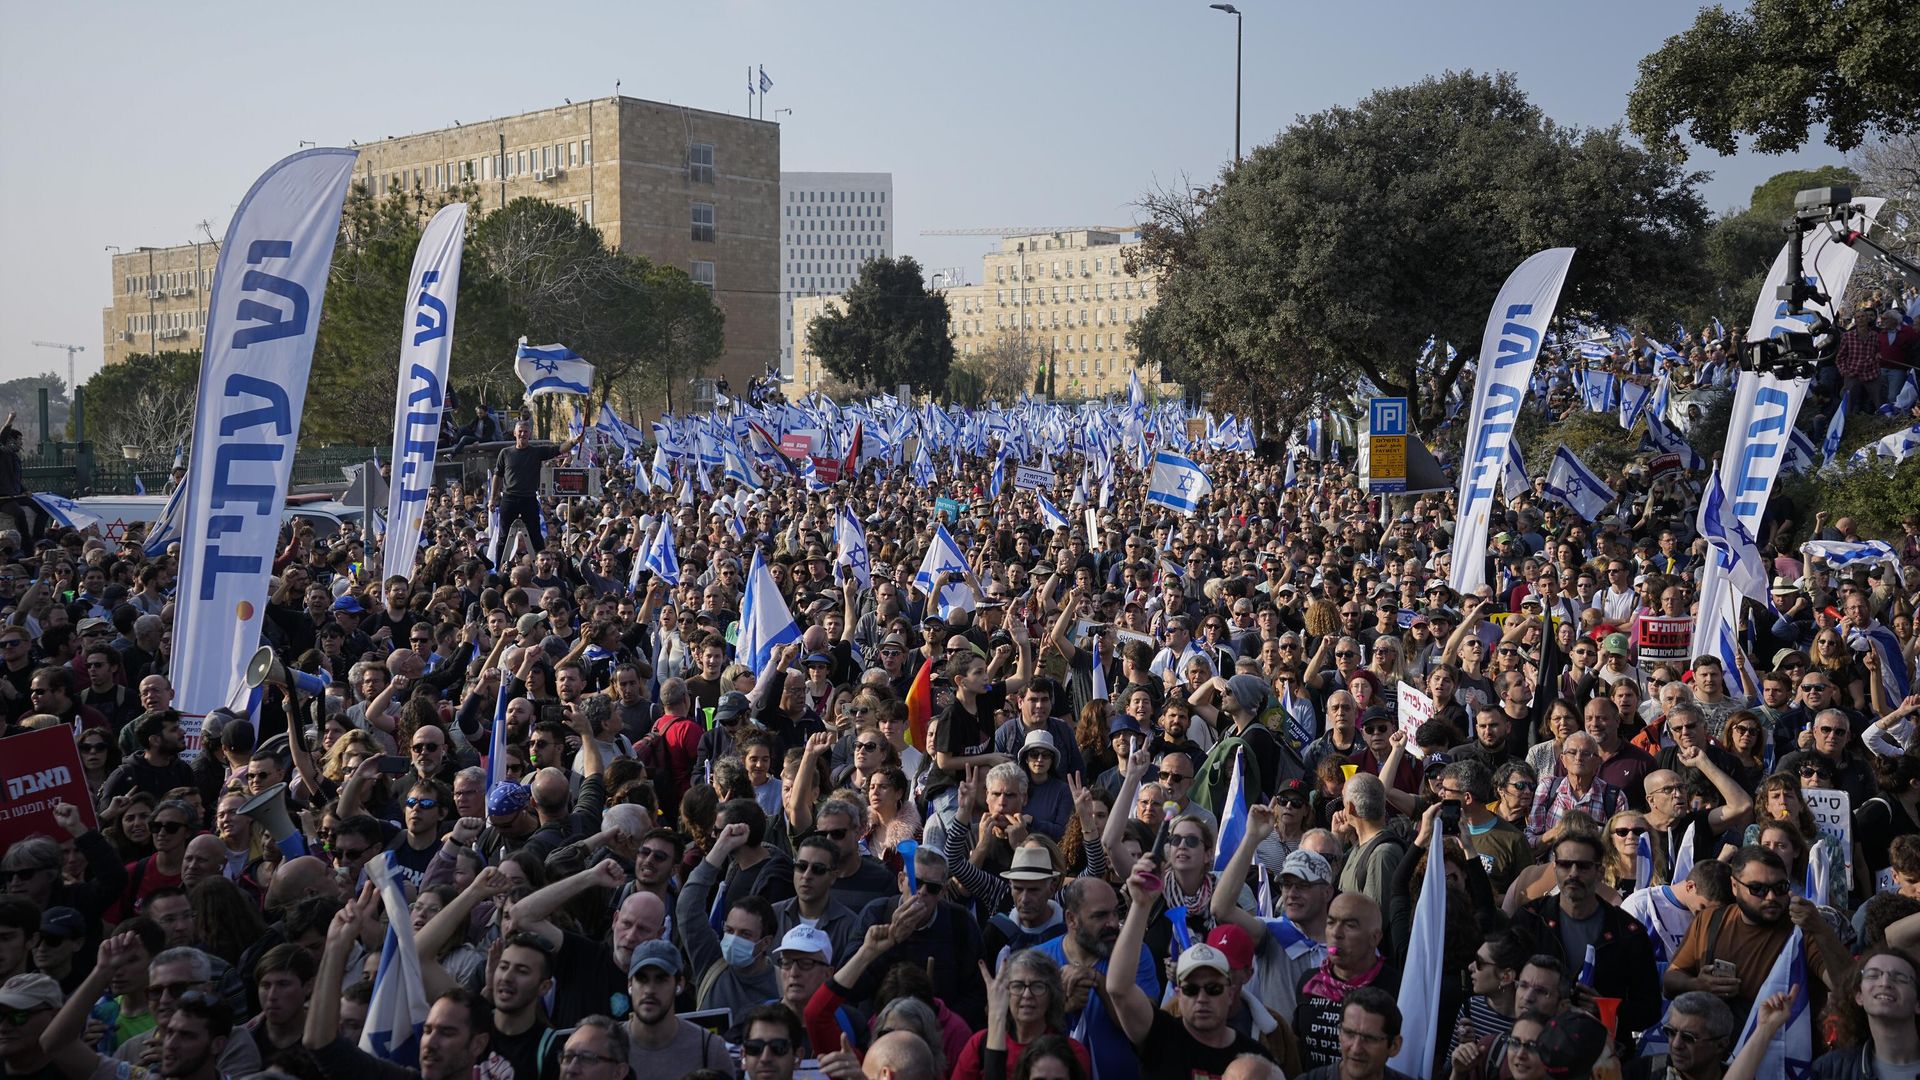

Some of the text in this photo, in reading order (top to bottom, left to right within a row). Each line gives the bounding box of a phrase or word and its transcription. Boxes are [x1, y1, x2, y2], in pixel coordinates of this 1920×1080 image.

[200, 240, 310, 601] יש עתיד
[398, 271, 447, 520] יש עתיד
[1464, 304, 1540, 516] יש עתיד
[1732, 387, 1789, 516] עתי
[1023, 472, 1048, 482] מלחמת
[7, 765, 72, 800] מאבק
[1806, 795, 1841, 810] סיימ
